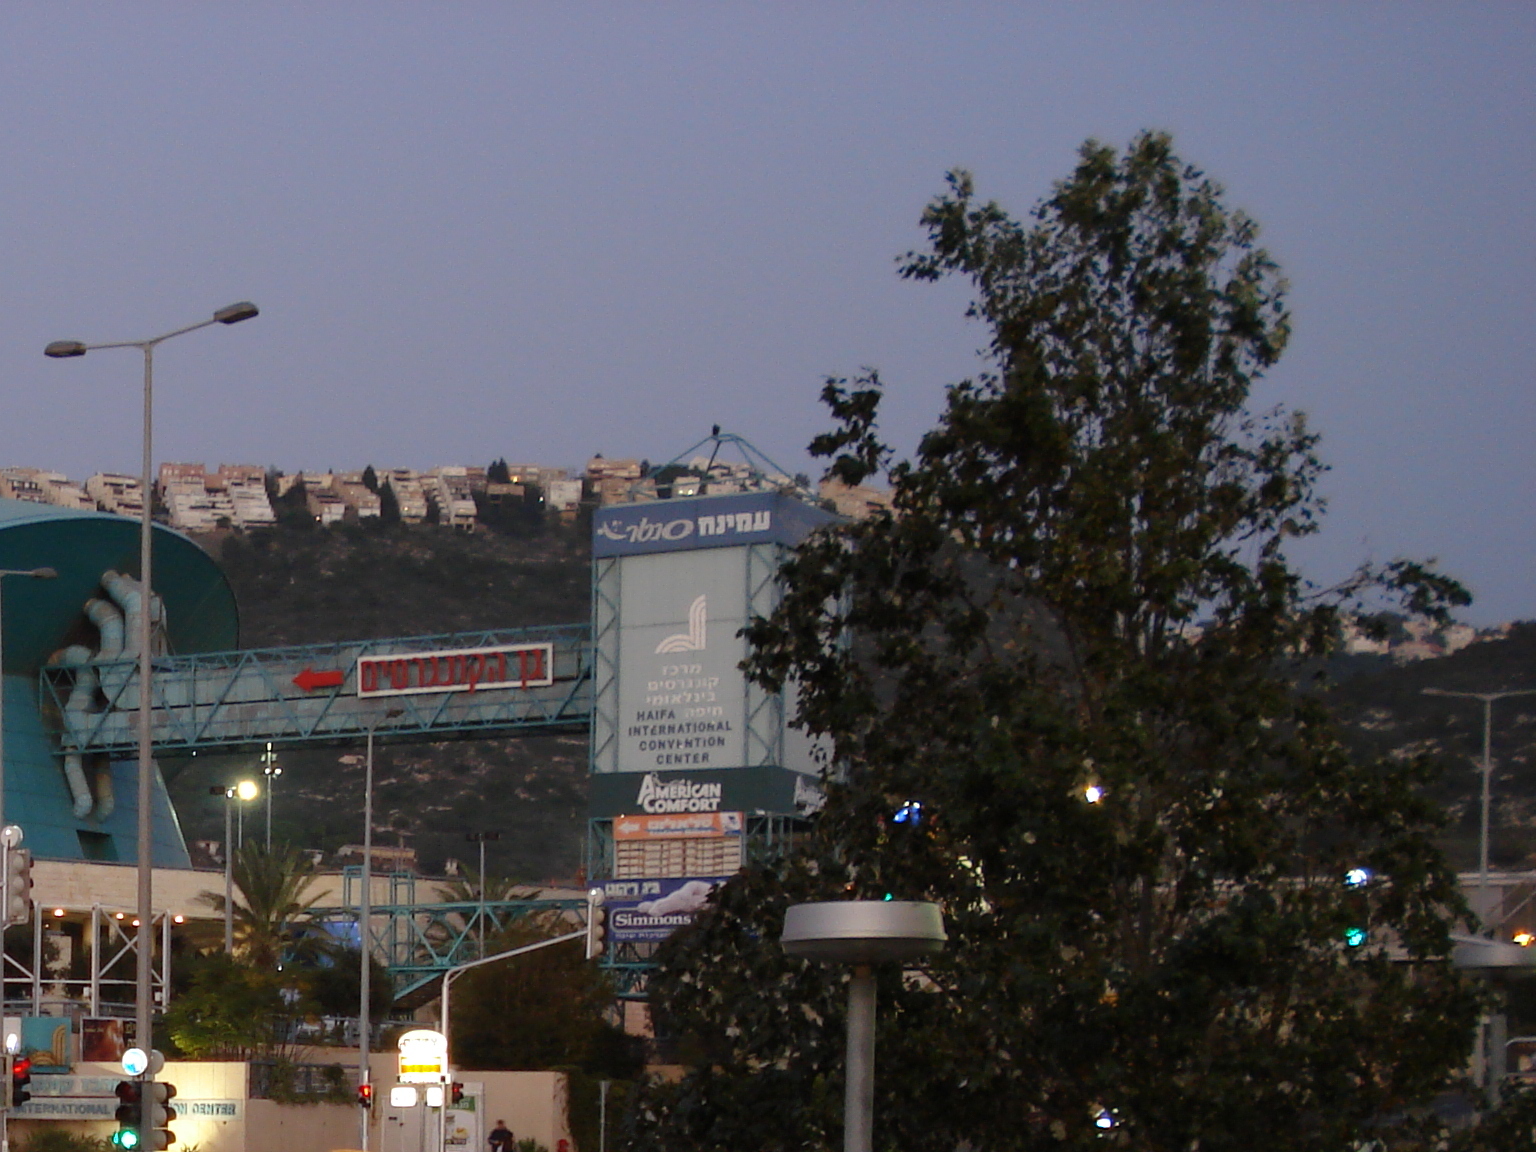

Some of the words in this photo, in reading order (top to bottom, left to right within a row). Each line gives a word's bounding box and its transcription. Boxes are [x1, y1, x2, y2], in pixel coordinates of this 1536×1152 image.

[698, 511, 771, 536] עמינח
[361, 651, 505, 694] הקונגרסים
[518, 648, 545, 690] גן
[636, 708, 676, 722] HAIFA
[628, 720, 732, 737] INTERNATIONAL
[639, 736, 726, 752] CONVENTION
[656, 752, 710, 765] CENTER
[614, 913, 692, 927] Simmons
[192, 1103, 237, 1116] CENTER
